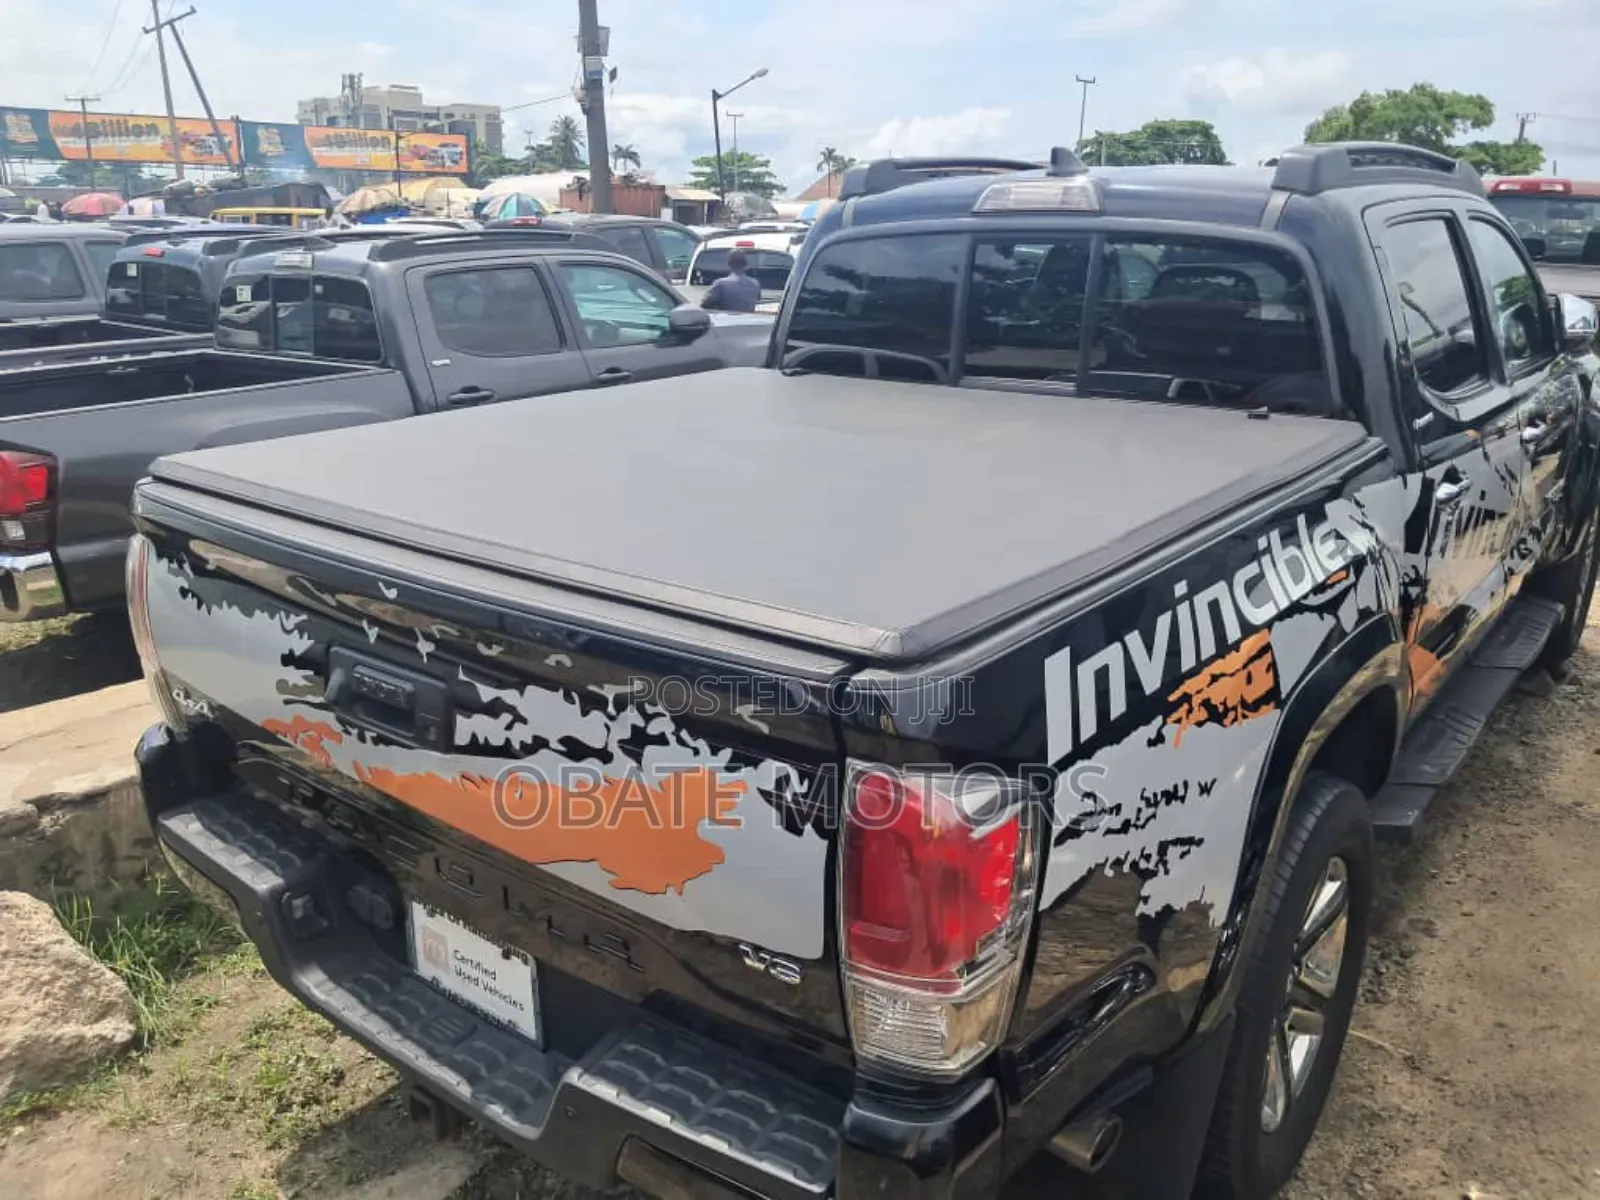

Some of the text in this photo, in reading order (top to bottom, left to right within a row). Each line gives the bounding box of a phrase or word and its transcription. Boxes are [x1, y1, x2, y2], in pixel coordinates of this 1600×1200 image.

[1044, 513, 1348, 766] Invincible
[452, 949, 497, 981] Certified
[454, 964, 480, 987] Used
[481, 980, 525, 1012] Vehicles
